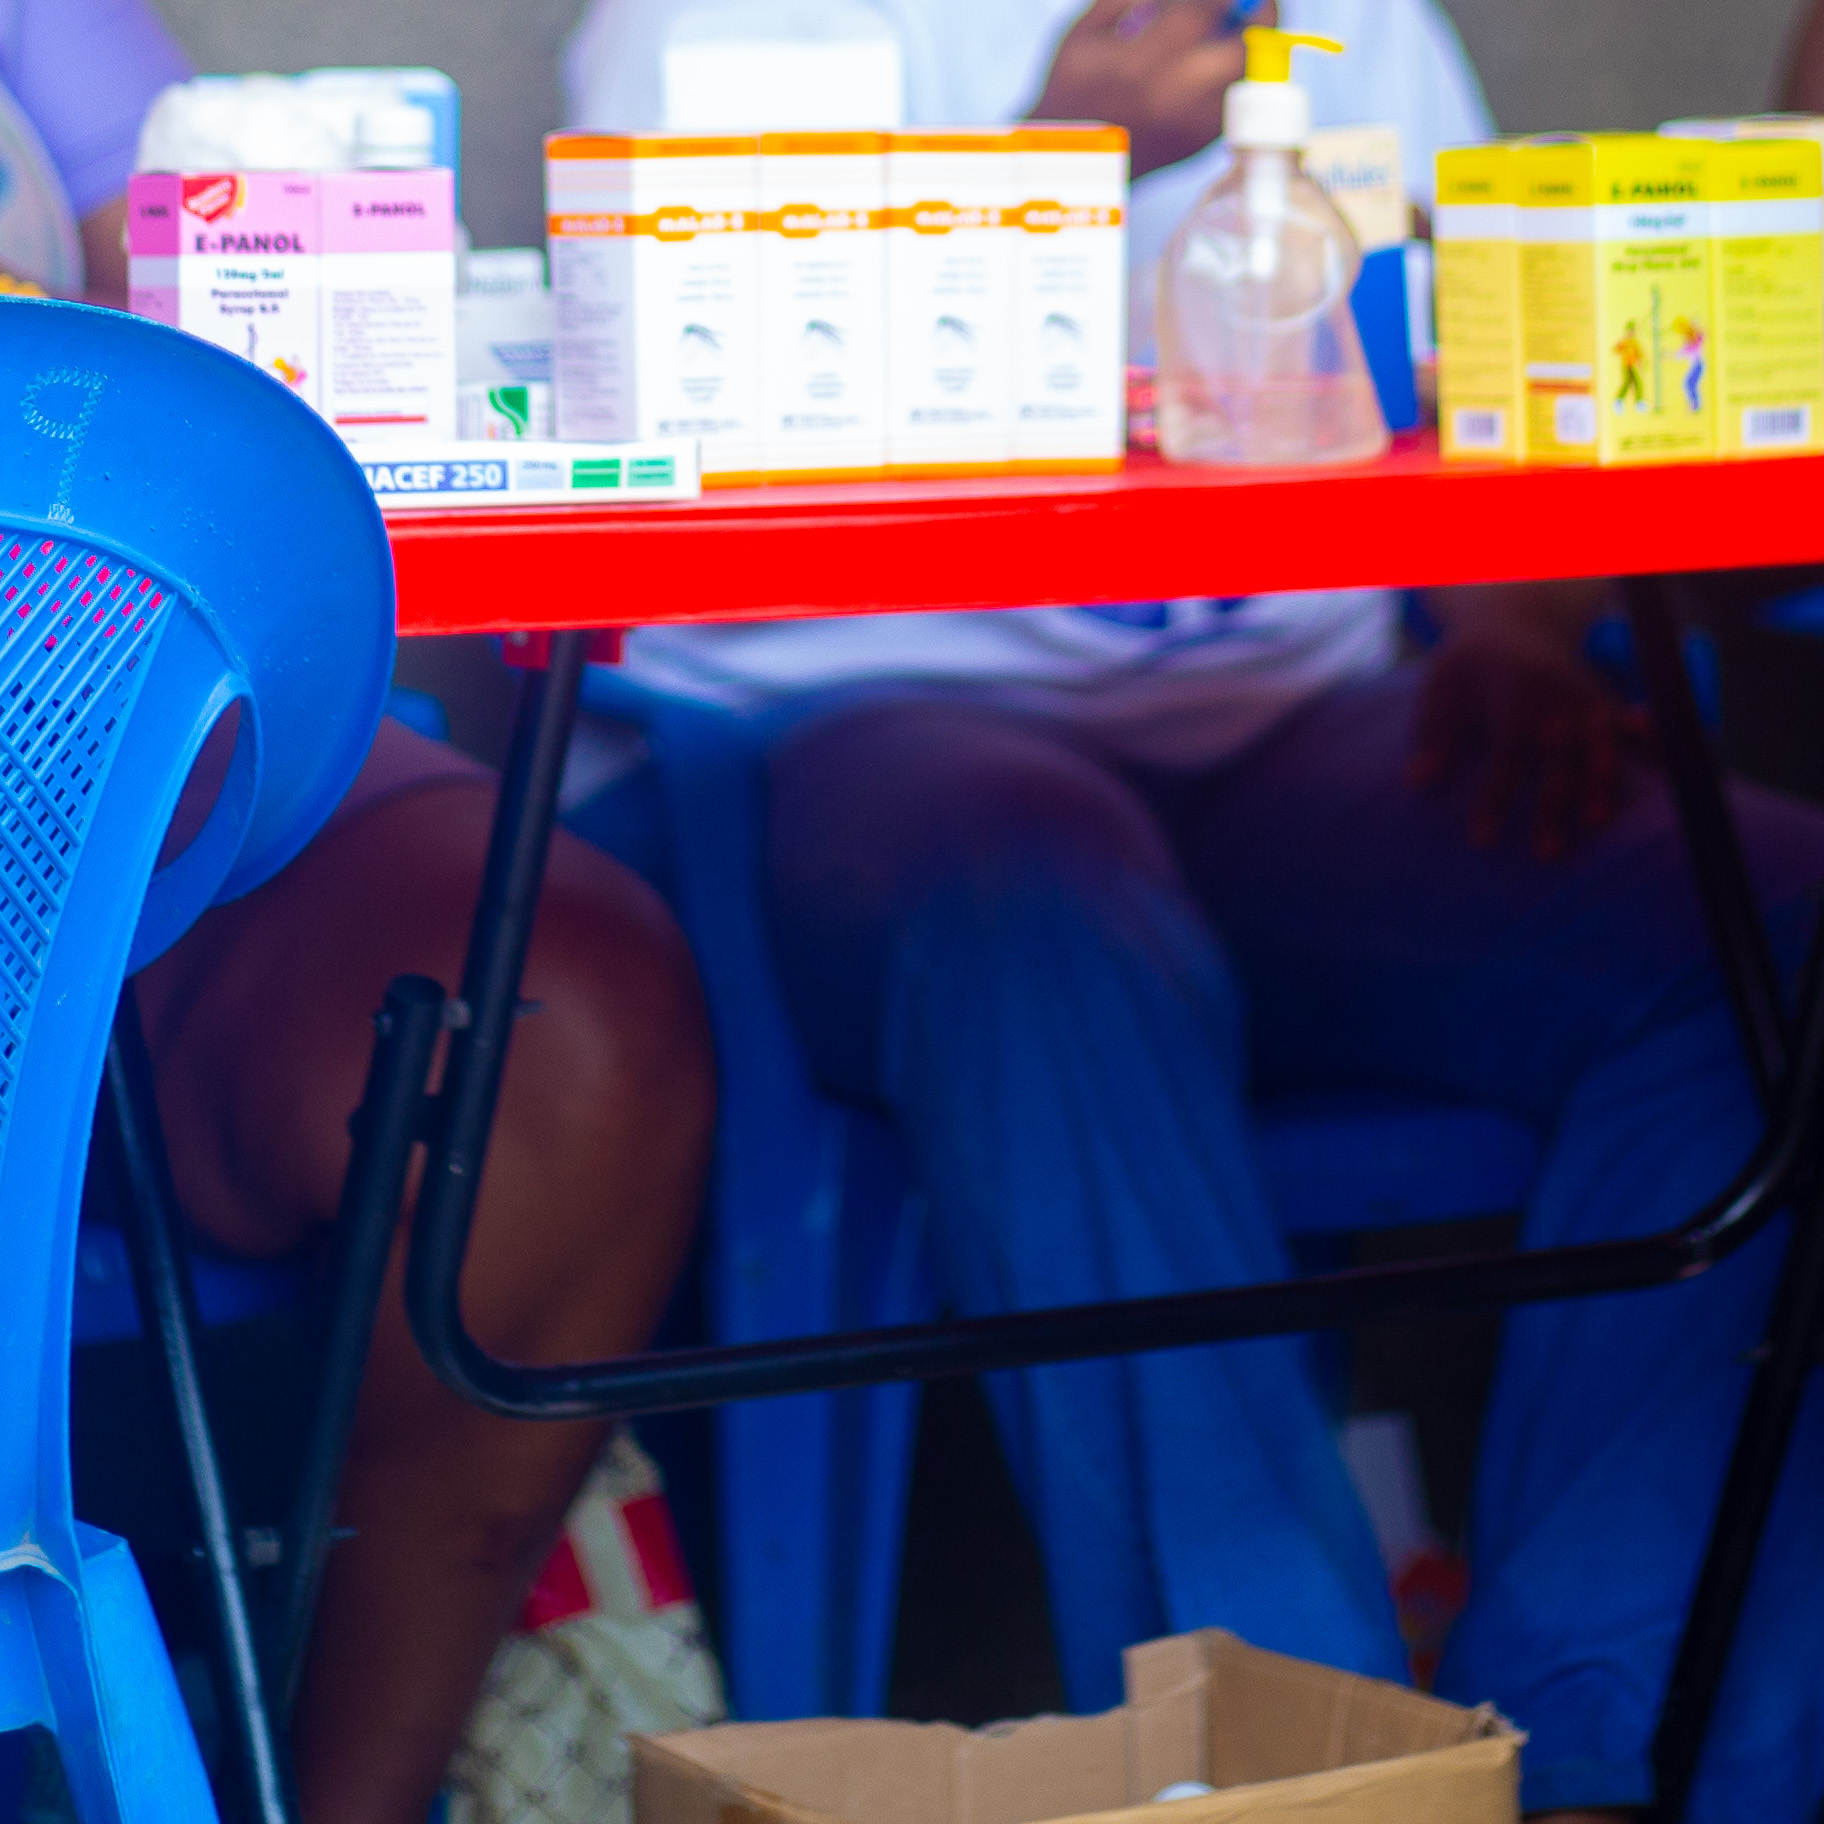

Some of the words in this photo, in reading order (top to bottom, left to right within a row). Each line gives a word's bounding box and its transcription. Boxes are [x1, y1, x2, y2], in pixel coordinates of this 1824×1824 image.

[353, 202, 427, 217] E-PANOL
[194, 233, 305, 253] E-PANOL
[451, 463, 502, 489] 250
